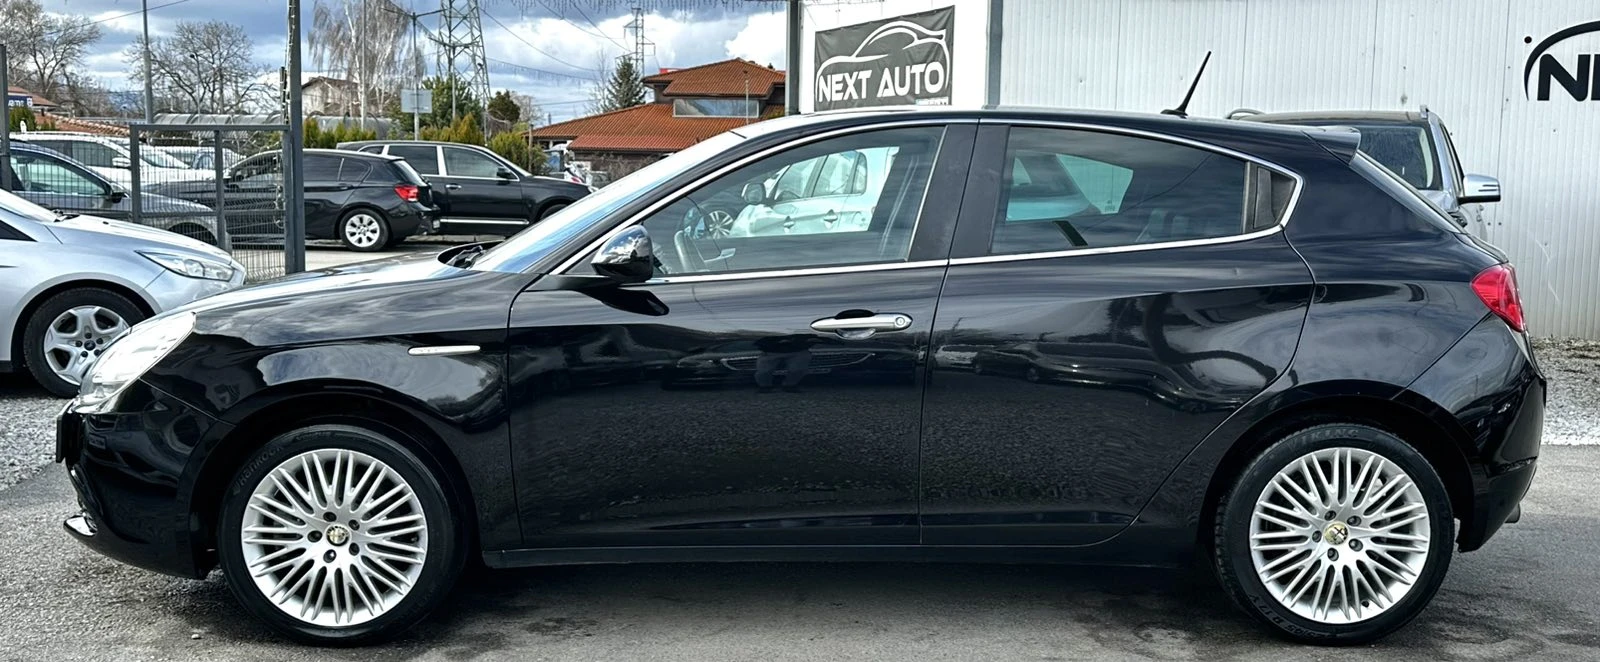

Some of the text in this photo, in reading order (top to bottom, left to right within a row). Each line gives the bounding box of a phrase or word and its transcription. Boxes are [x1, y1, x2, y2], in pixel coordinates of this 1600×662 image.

[819, 61, 944, 102] NEXT AUTO
[1537, 53, 1600, 101] N
